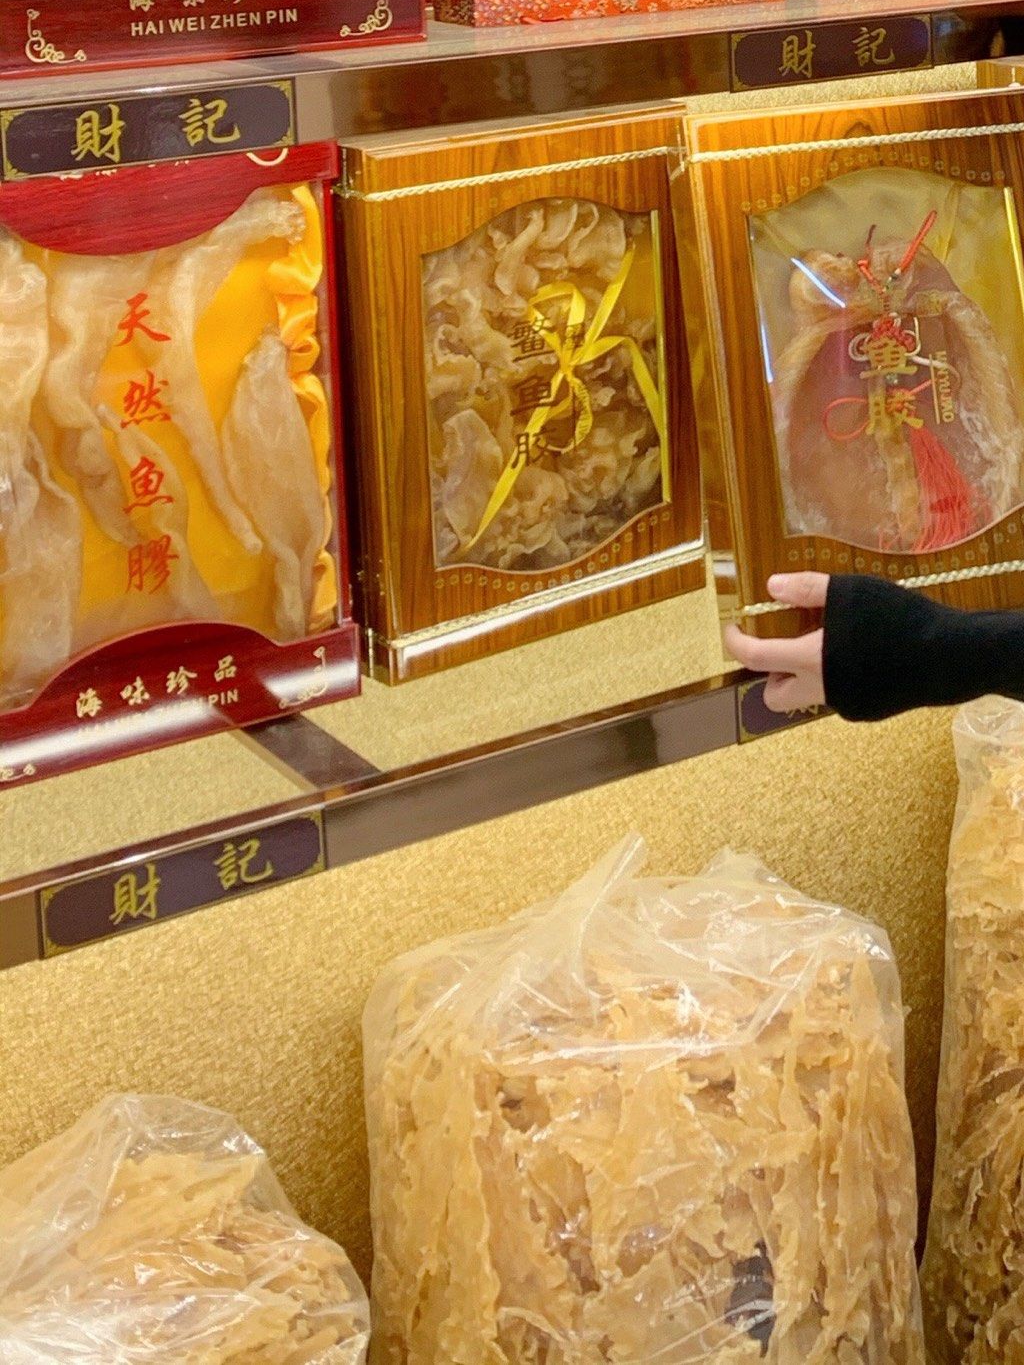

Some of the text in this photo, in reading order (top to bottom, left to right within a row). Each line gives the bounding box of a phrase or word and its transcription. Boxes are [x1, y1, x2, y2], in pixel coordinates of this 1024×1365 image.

[130, 8, 298, 37] HAI WEI ZHEN PIN
[779, 27, 896, 78] 財記
[71, 98, 241, 163] 財記
[75, 654, 238, 719] 海味珍品
[208, 689, 240, 707] PIN
[108, 837, 274, 926] 財記
